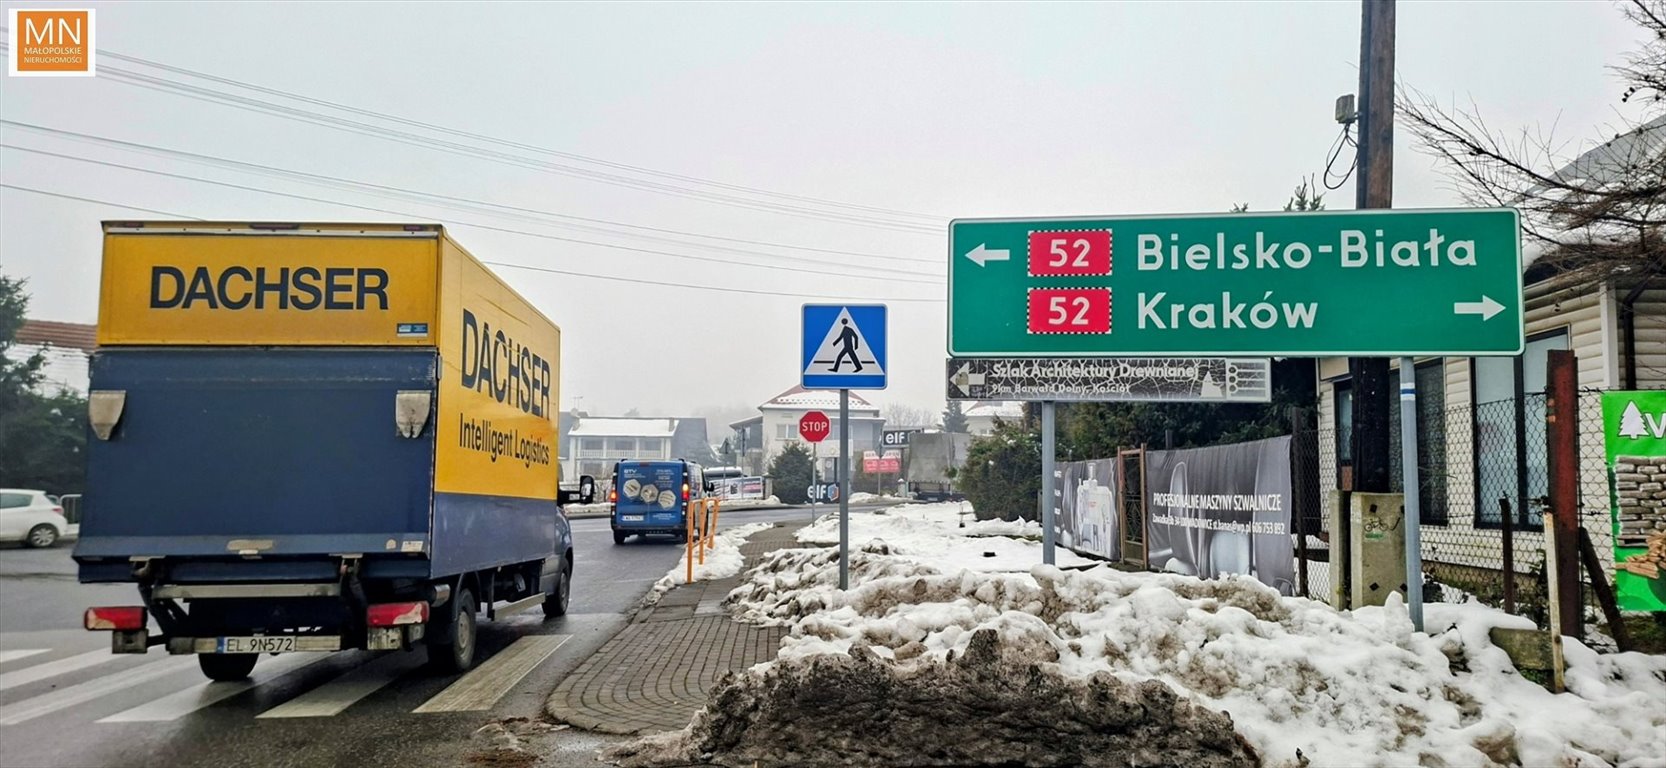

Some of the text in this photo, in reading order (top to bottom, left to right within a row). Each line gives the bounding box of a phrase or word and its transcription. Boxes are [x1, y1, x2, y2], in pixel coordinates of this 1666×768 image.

[1047, 228, 1478, 271] 52 Bielsko-Biała
[149, 266, 389, 310] DACHSER
[1047, 290, 1319, 330] 52 Kraków
[461, 308, 551, 421] DACHSER
[992, 363, 1198, 380] Szlak Architektury Drewnianej
[801, 421, 829, 432] STOP
[459, 413, 550, 469] Intelligent Logistics
[885, 432, 906, 444] elf
[807, 484, 827, 499] elf
[1200, 494, 1233, 511] MASZYNY
[1233, 494, 1282, 511] SZWALNICZE
[226, 638, 293, 652] EL 9N572
